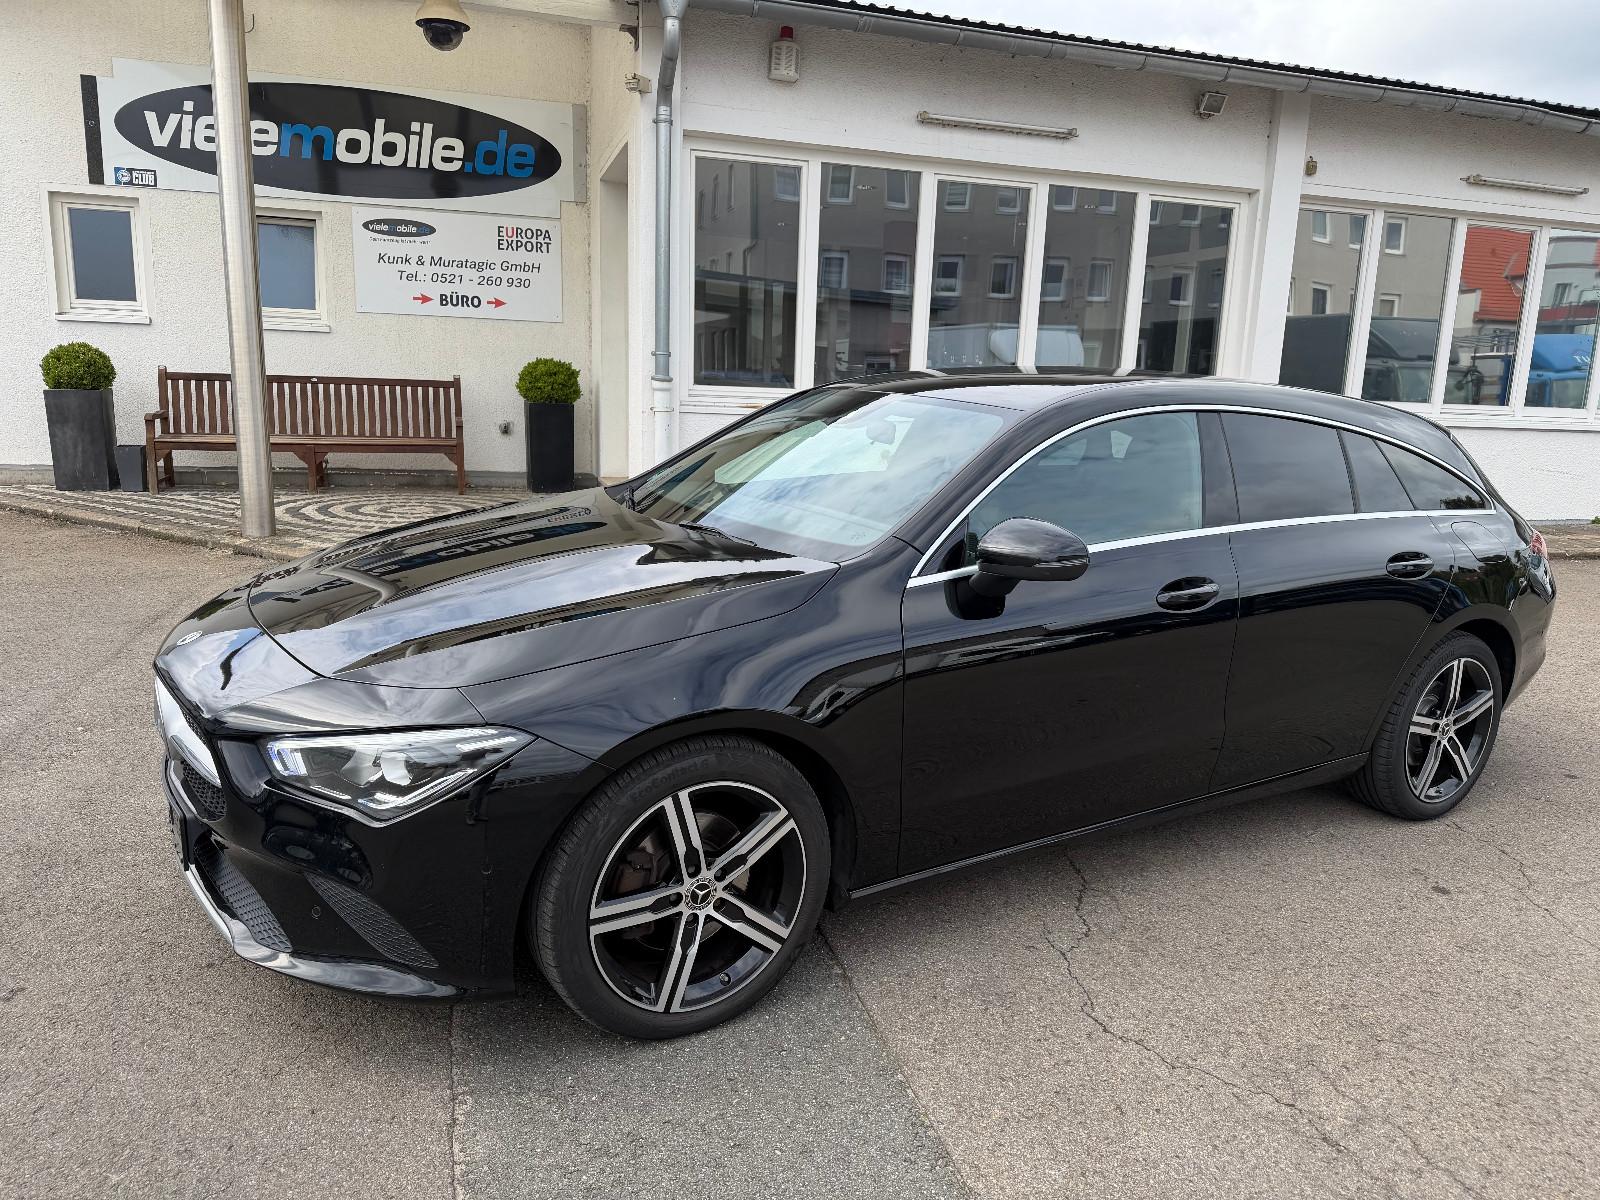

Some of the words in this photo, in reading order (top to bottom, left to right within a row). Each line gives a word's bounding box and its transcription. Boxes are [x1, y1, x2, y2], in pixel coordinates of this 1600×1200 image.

[143, 100, 535, 178] vieemobile.de
[132, 172, 155, 186] CLUB
[497, 225, 552, 241] EUROPA
[497, 239, 552, 254] EXPORT
[377, 252, 412, 266] Kunk
[415, 255, 425, 267] &
[429, 256, 497, 273] Muratagic
[500, 260, 541, 274] GmbH
[397, 270, 427, 283] Tel.:
[431, 272, 463, 285] 0521
[477, 275, 502, 287] 260
[506, 277, 531, 289] 930
[439, 291, 482, 308] BÜRO
